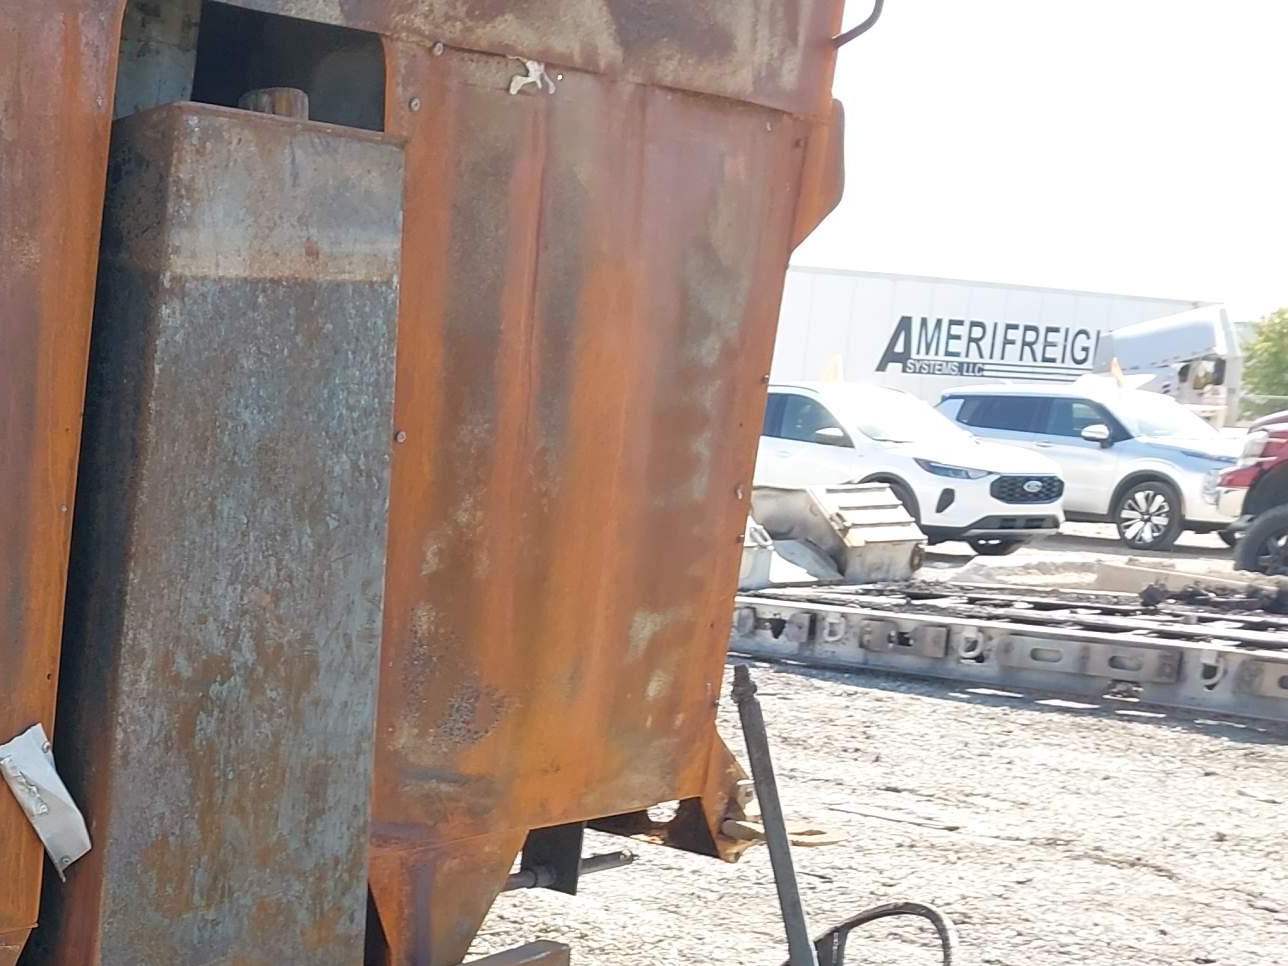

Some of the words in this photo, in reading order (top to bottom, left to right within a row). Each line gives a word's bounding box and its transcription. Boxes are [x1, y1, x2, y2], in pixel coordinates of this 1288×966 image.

[875, 315, 1101, 373] AMERIFREIG
[905, 359, 961, 376] SYSTEMS,
[962, 363, 985, 377] LLC
